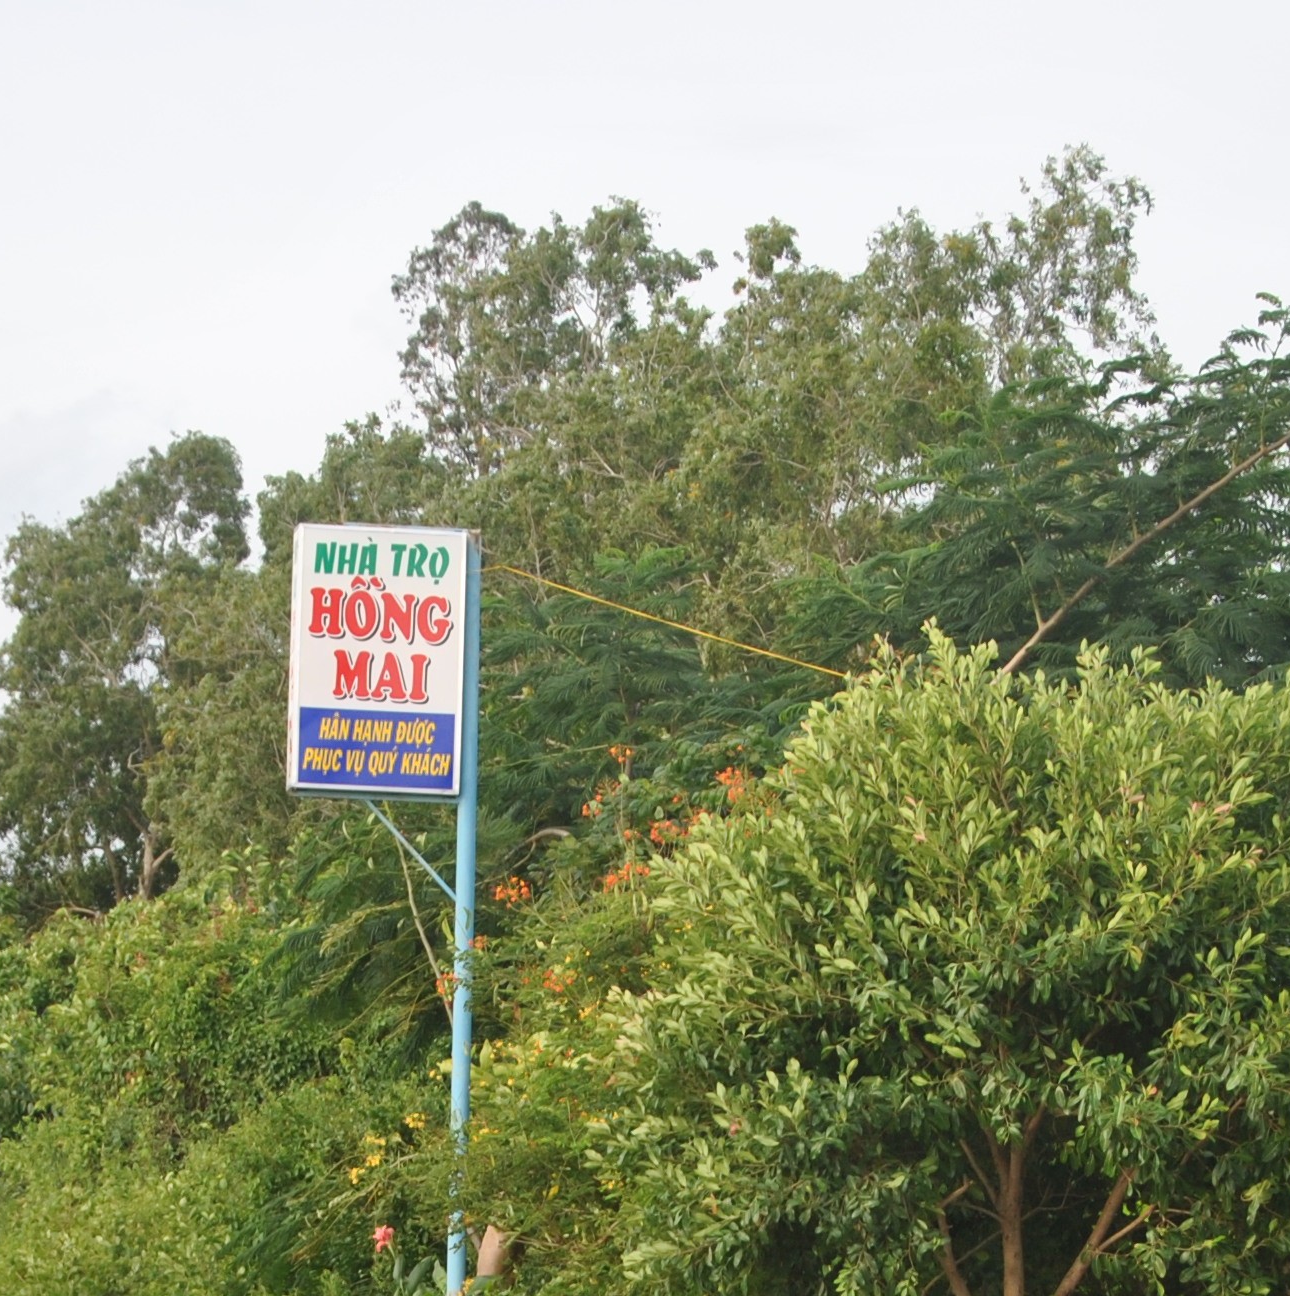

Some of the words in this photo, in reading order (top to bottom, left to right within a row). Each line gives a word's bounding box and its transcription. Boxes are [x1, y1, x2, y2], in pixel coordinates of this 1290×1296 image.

[314, 537, 378, 576] NHÀ
[391, 542, 450, 585] TRỌ
[308, 575, 454, 646] HỒNG
[332, 649, 432, 705] MAI
[352, 719, 394, 747] HẠNH
[395, 717, 436, 749] ĐƯỢC
[302, 747, 343, 776] PHỤC
[345, 748, 366, 777] VỤ
[368, 745, 399, 777] QUÝ
[400, 747, 452, 777] KHÁCH
